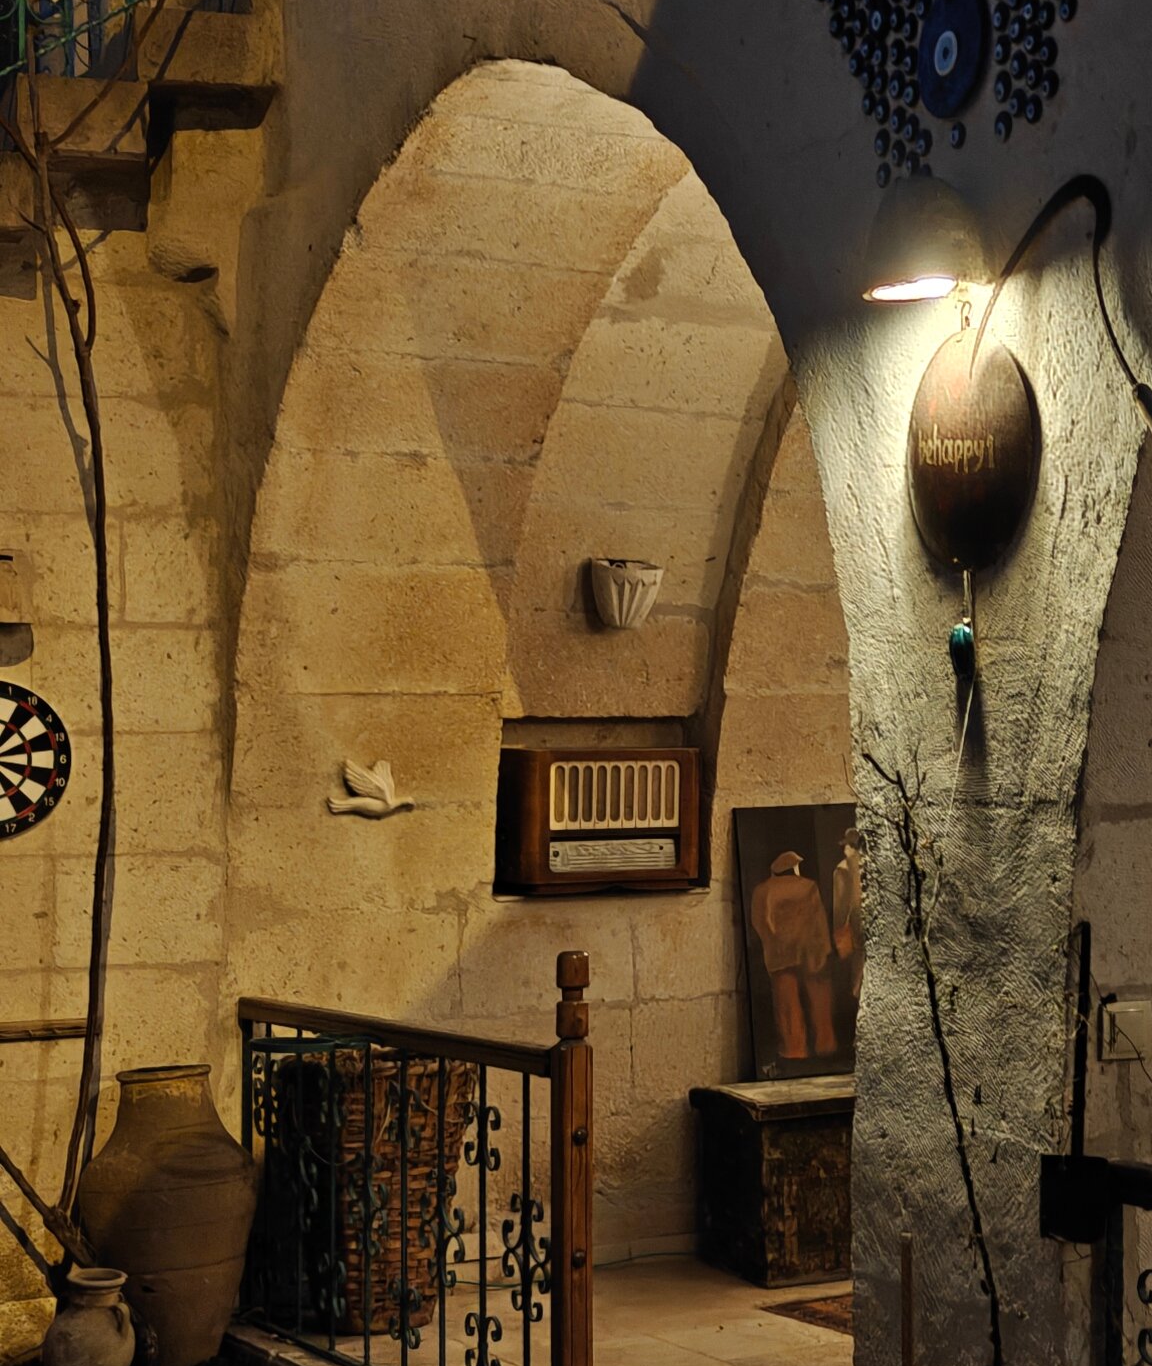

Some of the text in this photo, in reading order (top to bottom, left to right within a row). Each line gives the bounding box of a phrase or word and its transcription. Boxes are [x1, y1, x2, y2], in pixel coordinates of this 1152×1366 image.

[46, 714, 53, 723] 4
[60, 755, 67, 764] 6
[55, 777, 65, 787] 10
[44, 796, 55, 806] 15
[28, 812, 35, 822] 2
[5, 823, 17, 833] 17
